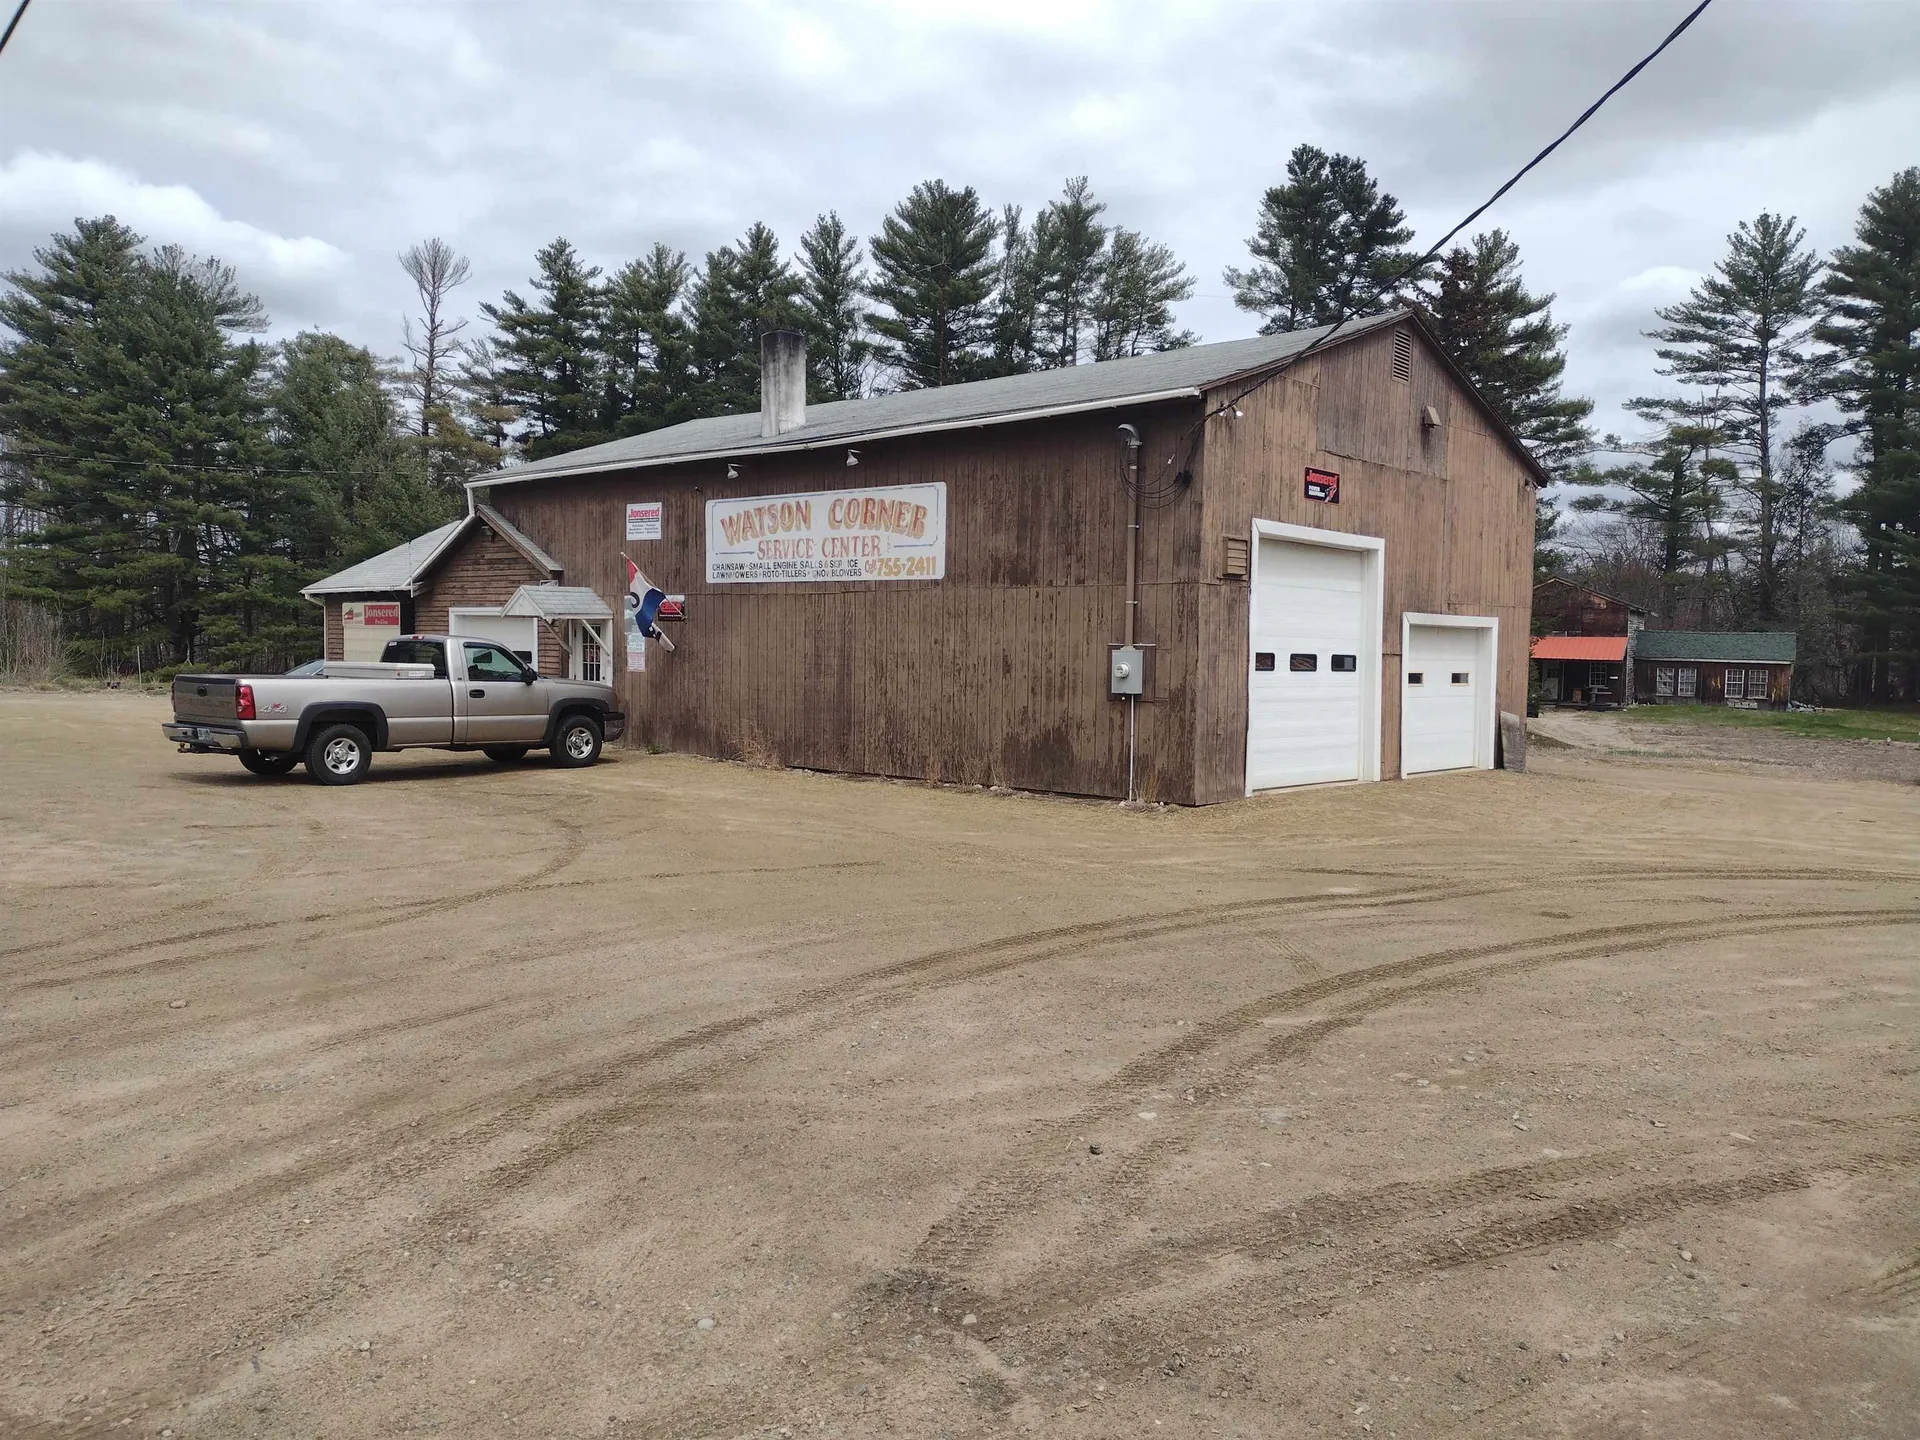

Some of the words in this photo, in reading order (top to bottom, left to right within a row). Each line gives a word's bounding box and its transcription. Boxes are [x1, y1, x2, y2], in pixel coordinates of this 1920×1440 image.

[628, 506, 660, 518] Jonsered
[720, 499, 811, 546] WATSON
[828, 497, 928, 539] CORNER
[756, 537, 815, 560] SERVICE
[821, 535, 882, 559] CENTER
[748, 561, 771, 570] SMALL
[773, 561, 798, 570] ENGINE
[800, 560, 823, 569] SALS
[877, 556, 937, 577] 755-2411
[364, 605, 398, 618] Jonsered
